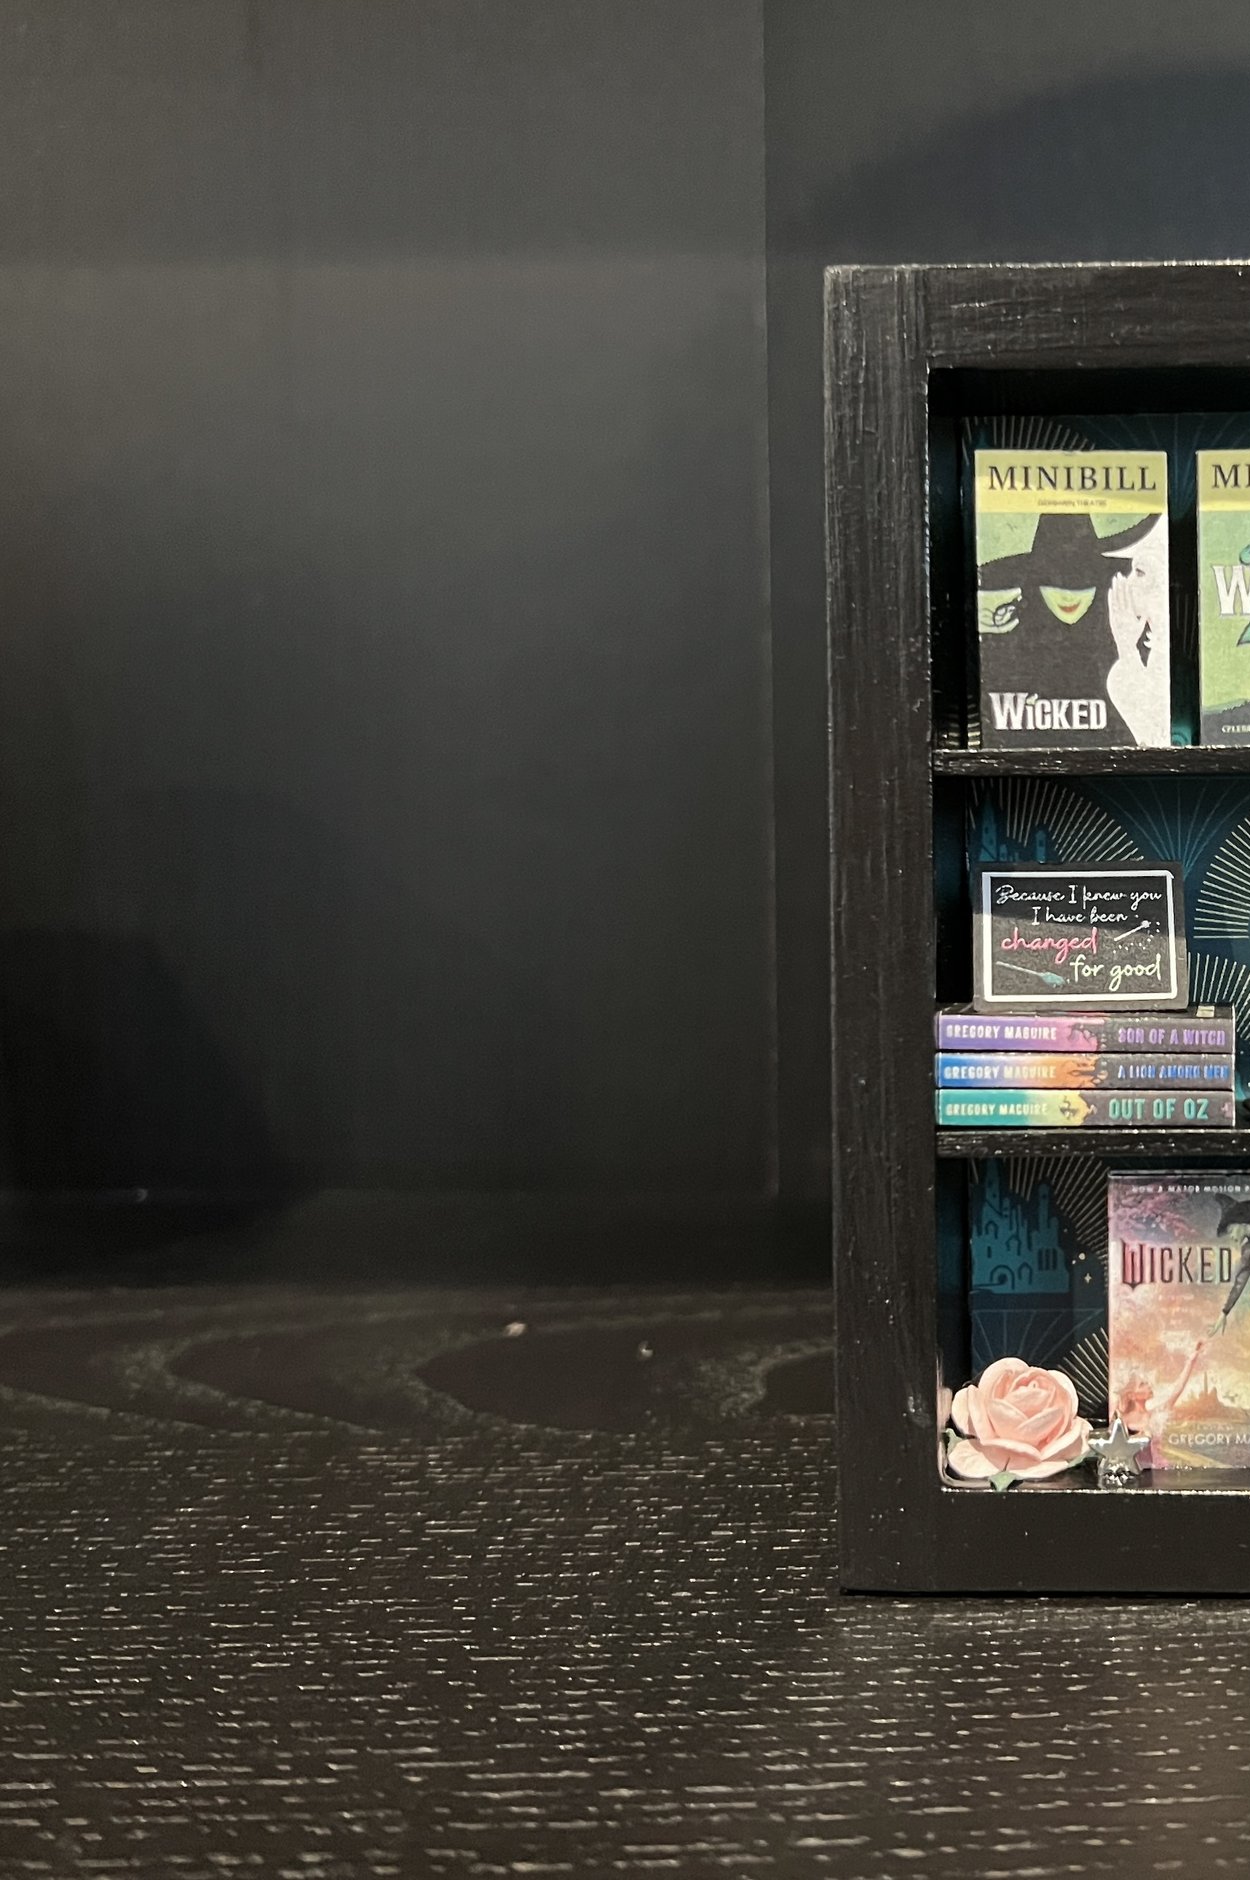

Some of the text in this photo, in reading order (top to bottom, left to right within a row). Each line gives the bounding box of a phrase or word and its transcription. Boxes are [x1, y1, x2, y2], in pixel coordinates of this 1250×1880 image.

[989, 465, 1156, 491] MINIBILL
[995, 884, 1162, 910] Because I knew you
[1032, 906, 1128, 925] I have been
[1001, 926, 1098, 964] changed
[1069, 952, 1161, 992] for good
[946, 1024, 1057, 1040] GREGORY MAGUIRE
[1118, 1027, 1225, 1046] SON OF A WITCH
[944, 1066, 1057, 1079] GREGORY MAGUIRE
[1117, 1065, 1126, 1079] A
[1129, 1065, 1156, 1079] LION
[1203, 1064, 1229, 1080] MEN
[945, 1103, 1048, 1116] GREGORY MAGUIRE
[1109, 1097, 1209, 1120] OUT OF OZ
[1168, 1185, 1200, 1193] MAJOR
[1204, 1185, 1240, 1193] MOTION
[1120, 1239, 1232, 1289] WICKED
[1168, 1433, 1232, 1446] GREGORY
